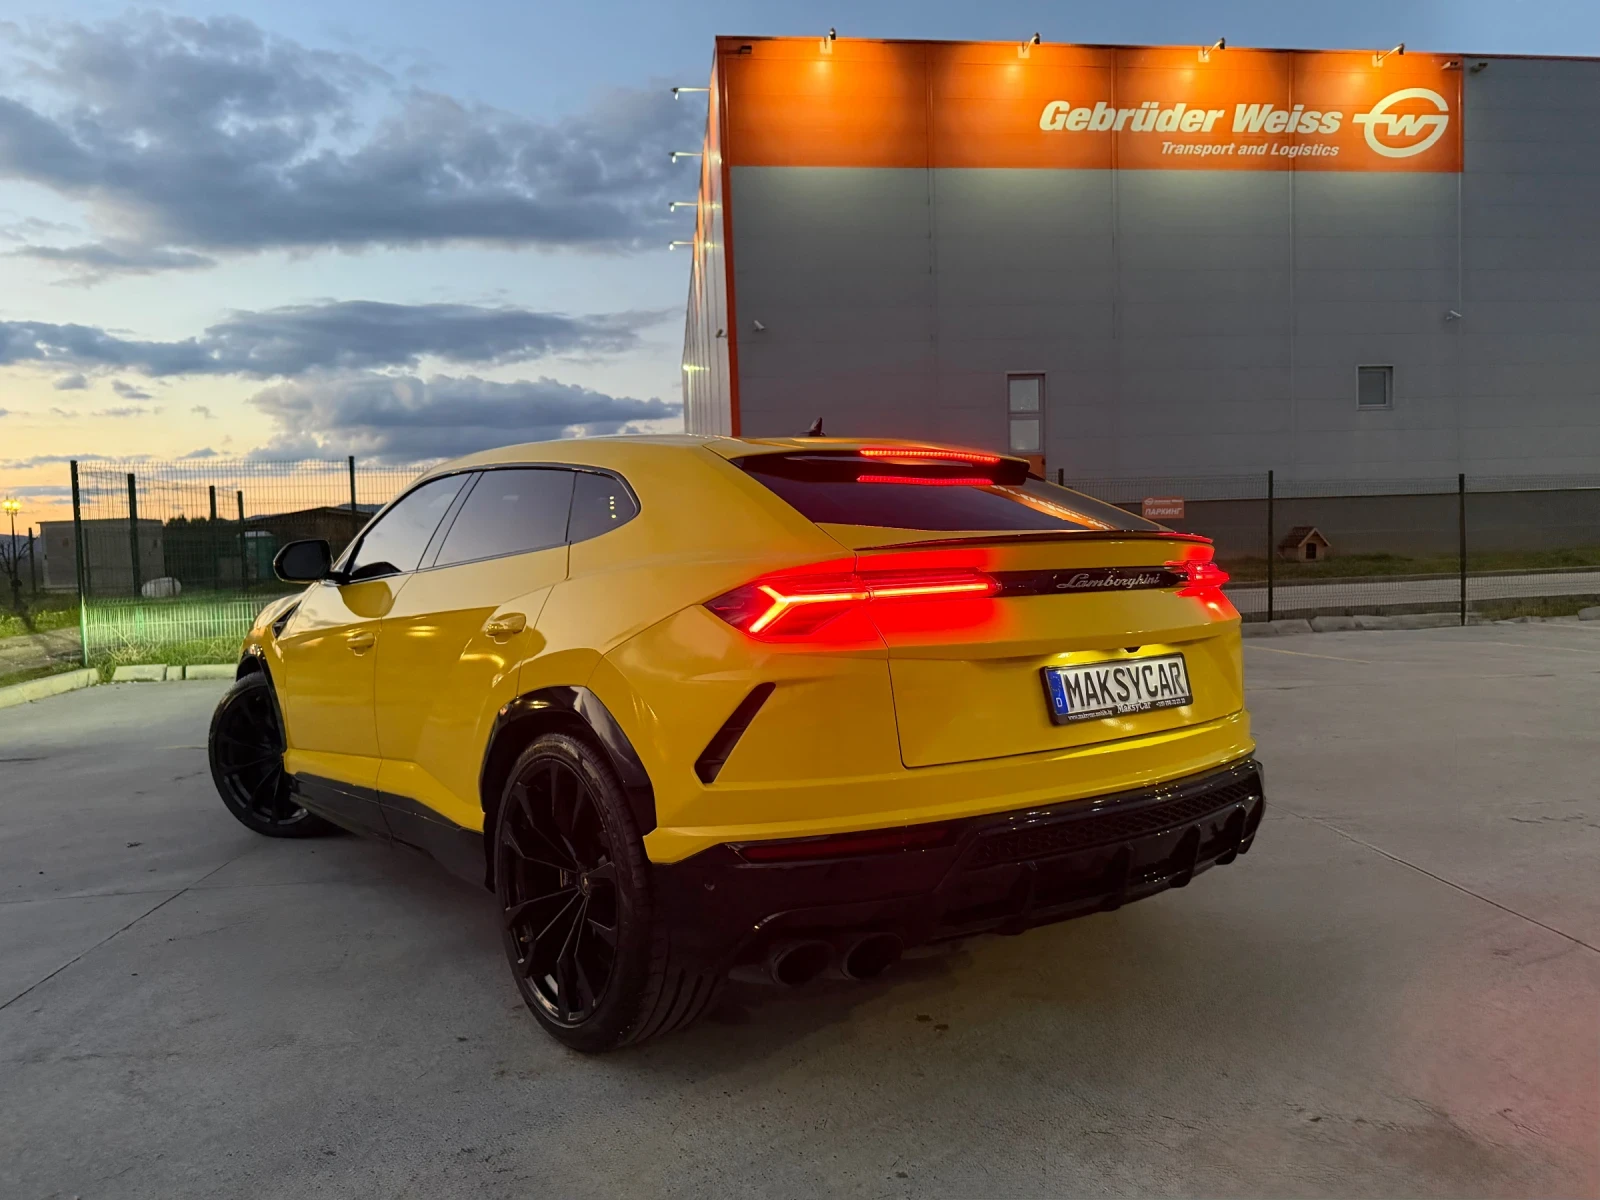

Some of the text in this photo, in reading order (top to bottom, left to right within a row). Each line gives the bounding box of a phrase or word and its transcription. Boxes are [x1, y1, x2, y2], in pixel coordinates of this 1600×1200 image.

[1039, 99, 1343, 135] Gebrüder Weiss
[1161, 141, 1339, 158] Transport and Logistics
[1144, 507, 1183, 516] ПАРКИНГ
[1056, 573, 1160, 589] Lamborghini
[1056, 662, 1185, 709] D MAKSYCAR
[1117, 701, 1151, 714] MaksyCar
